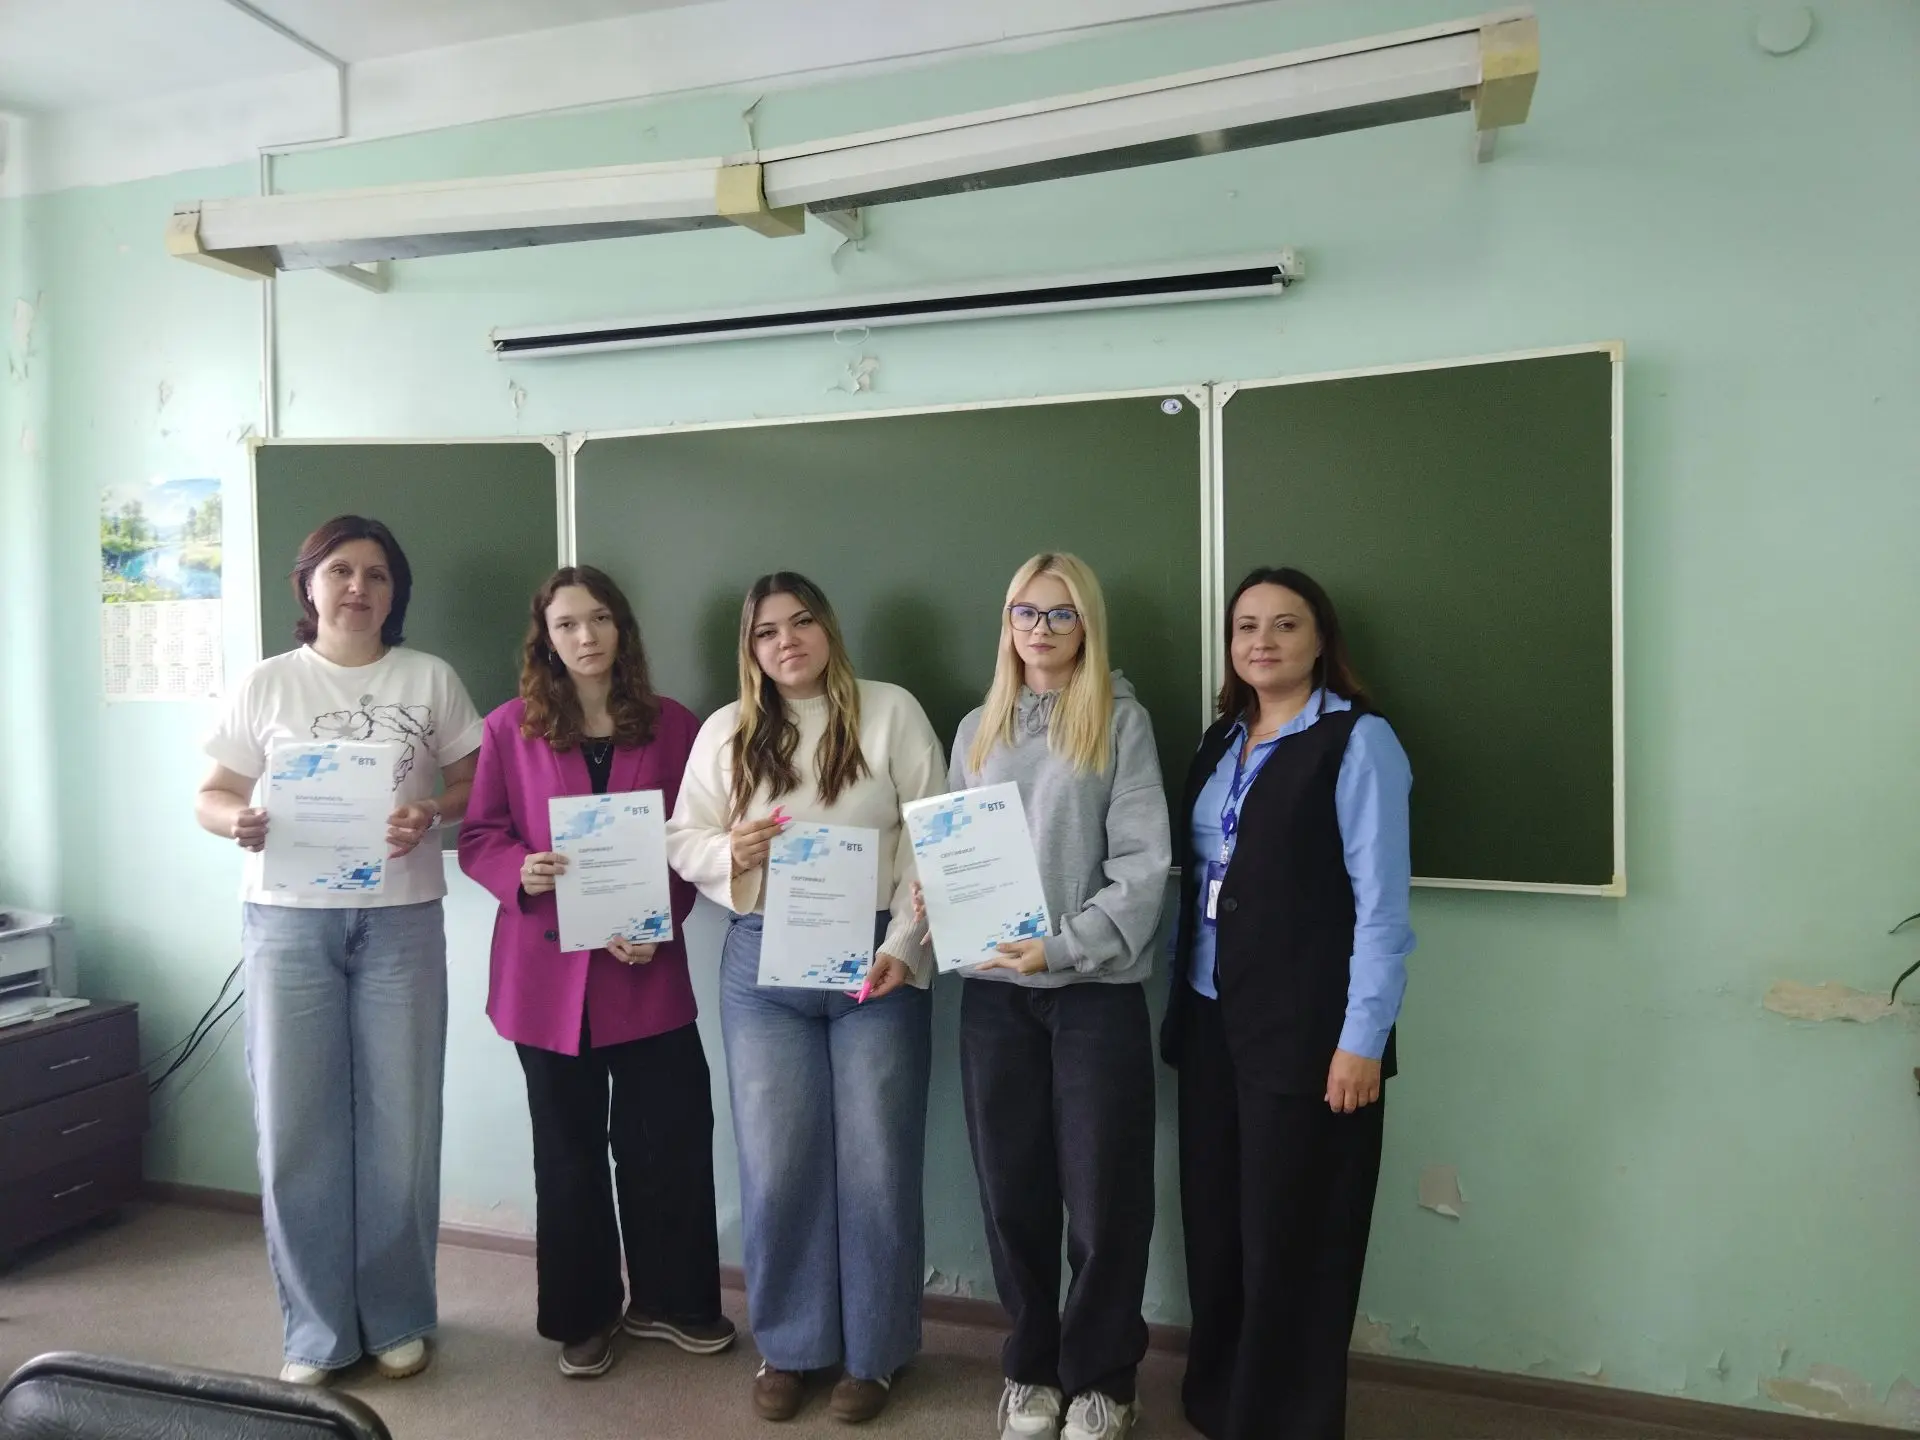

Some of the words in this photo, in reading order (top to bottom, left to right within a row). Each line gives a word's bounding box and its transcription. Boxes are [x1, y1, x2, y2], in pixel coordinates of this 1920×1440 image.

[358, 757, 376, 766] ВТБ
[632, 806, 650, 815] ВТБ
[988, 801, 1005, 811] ВТБ
[846, 843, 863, 852] ВТБ
